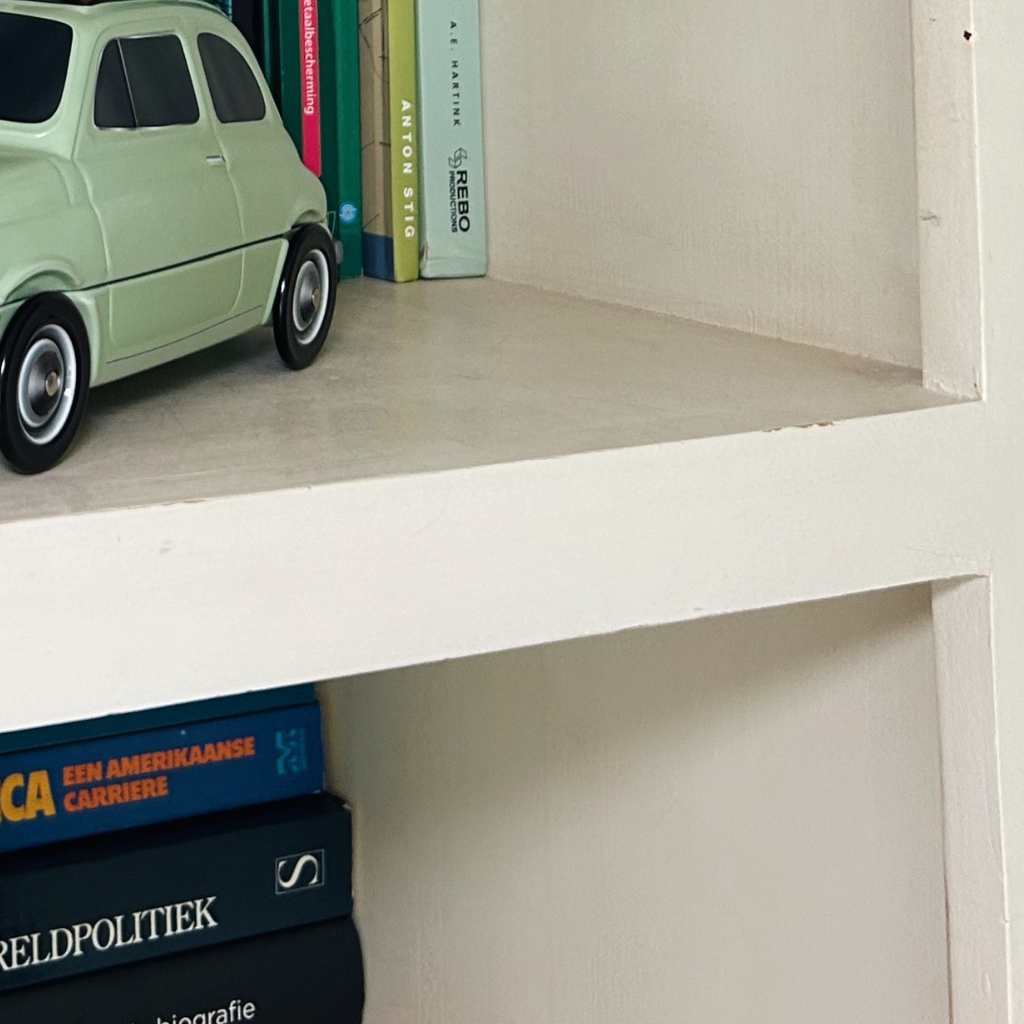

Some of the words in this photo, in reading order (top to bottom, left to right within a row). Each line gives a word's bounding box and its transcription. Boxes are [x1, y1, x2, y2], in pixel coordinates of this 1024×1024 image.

[451, 60, 462, 127] HARTINK
[401, 100, 413, 175] ANTON
[403, 186, 414, 238] STIG
[448, 170, 457, 233] PRODUCTIONS
[456, 170, 470, 232] REBO
[62, 762, 104, 787] EEN
[105, 734, 255, 779] AMERIKAANSE
[63, 775, 169, 812] CARRIERE
